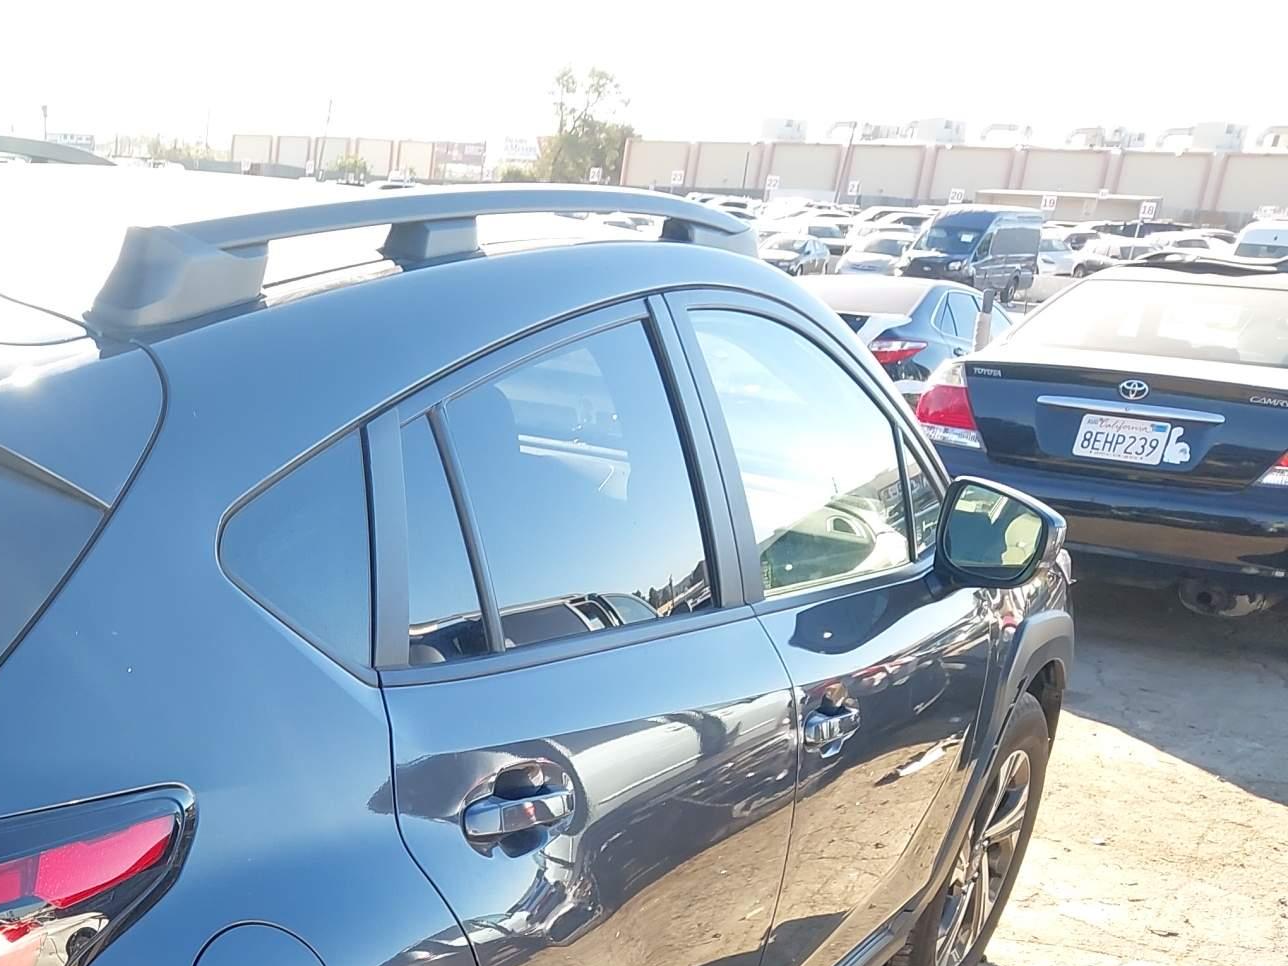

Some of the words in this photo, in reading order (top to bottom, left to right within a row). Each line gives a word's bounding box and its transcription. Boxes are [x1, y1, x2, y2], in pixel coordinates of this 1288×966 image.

[951, 191, 963, 201] 20
[1043, 198, 1055, 208] 19
[1142, 205, 1154, 216] 18
[973, 367, 1002, 377] TOYOTA
[1099, 417, 1150, 433] California
[1080, 430, 1159, 457] 8EHP239
